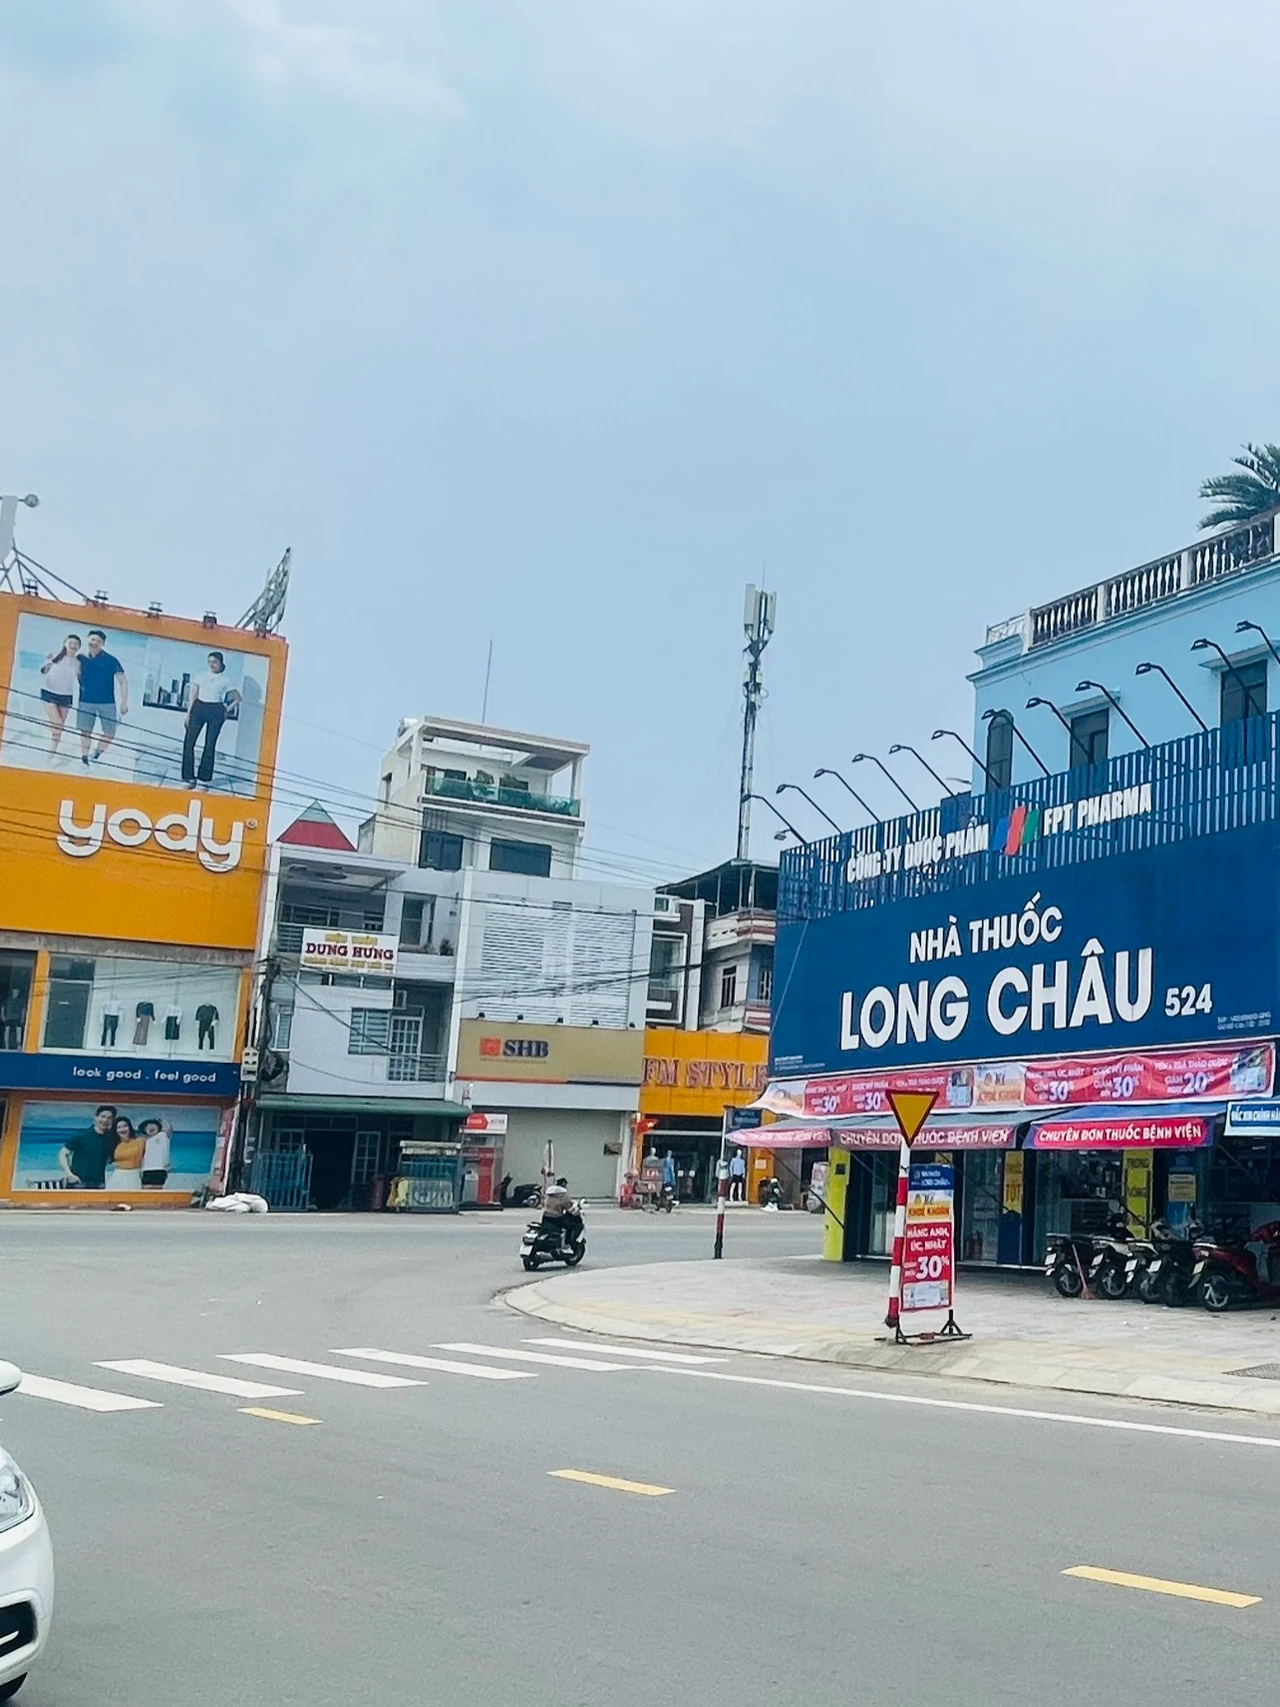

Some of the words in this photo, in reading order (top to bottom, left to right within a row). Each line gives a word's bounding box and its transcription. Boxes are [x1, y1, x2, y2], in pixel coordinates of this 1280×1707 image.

[1043, 806, 1074, 836] FPT
[1077, 783, 1152, 830] PHARMA
[57, 800, 243, 873] yody
[846, 847, 881, 882] CÔNG
[884, 846, 902, 874] TY
[909, 914, 961, 963] NHÀ
[970, 891, 1063, 953] THUỐC
[840, 975, 969, 1051] LONG
[987, 937, 1153, 1036] CHÂU
[1165, 983, 1213, 1017] 524
[503, 1039, 549, 1058] SHB
[73, 1066, 102, 1077] look
[106, 1069, 141, 1081] good
[154, 1069, 179, 1080] feel
[183, 1072, 216, 1084] good
[913, 1128, 944, 1144] HUỐC
[1039, 1126, 1080, 1142] CHUYÊN
[1081, 1127, 1103, 1142] ĐƠN
[1106, 1122, 1142, 1141] THUỐC
[1143, 1125, 1172, 1142] BỆNH
[1174, 1121, 1202, 1142] VIỆN
